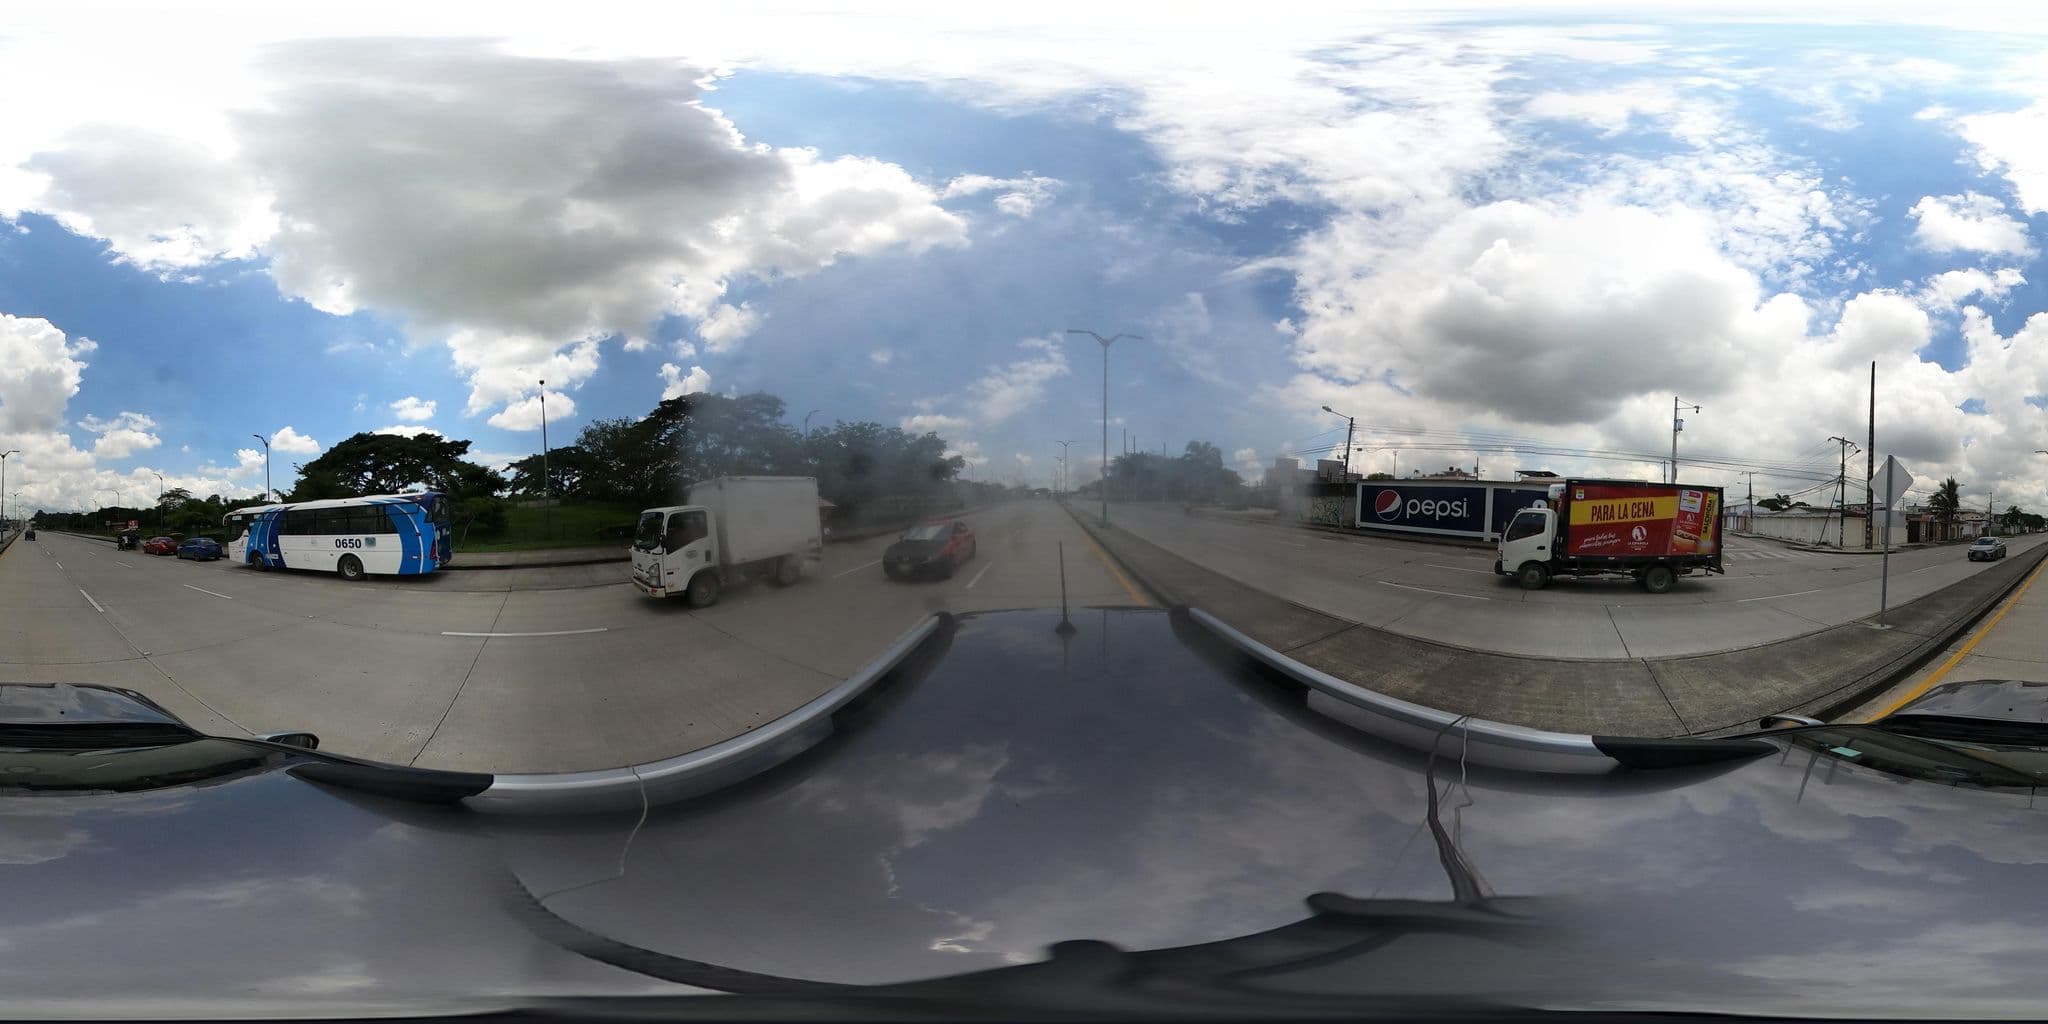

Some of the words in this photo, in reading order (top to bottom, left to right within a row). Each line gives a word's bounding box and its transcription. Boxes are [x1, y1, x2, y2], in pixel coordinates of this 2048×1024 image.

[1406, 497, 1468, 521] pepsi
[1591, 503, 1615, 521] PARA
[1617, 502, 1629, 520] LA
[1631, 500, 1655, 519] CENA
[335, 538, 362, 549] 0650
